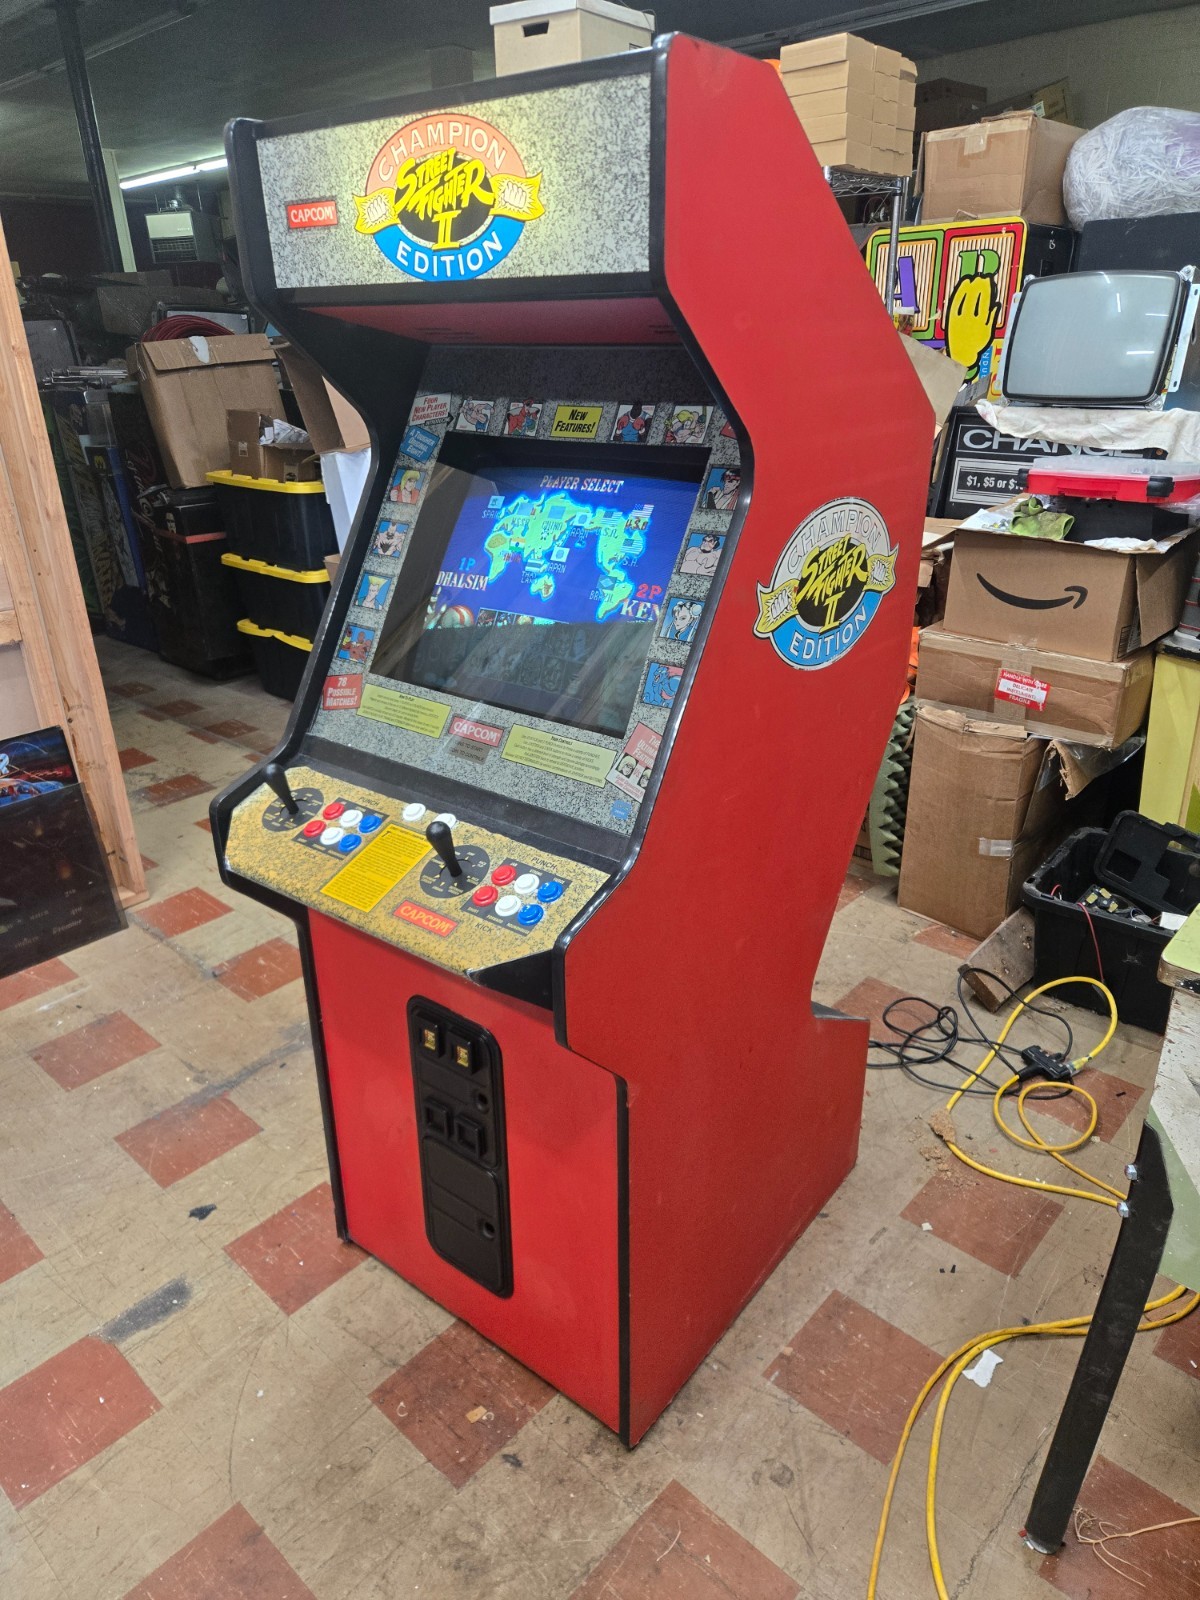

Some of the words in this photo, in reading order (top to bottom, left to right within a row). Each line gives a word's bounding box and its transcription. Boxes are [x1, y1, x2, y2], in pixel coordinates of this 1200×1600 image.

[379, 121, 507, 182] CHAMPION
[394, 147, 457, 214] STREET
[407, 158, 495, 221] FIGHTER
[290, 206, 334, 223] CAPCOM
[396, 231, 503, 277] EDITION
[568, 409, 588, 421] NEW
[554, 420, 597, 433] FEATURES!
[963, 429, 1143, 458] CHAN
[540, 475, 580, 490] PLAYER
[580, 478, 624, 493] SELECT
[966, 475, 981, 488] $1,
[983, 477, 995, 488] $5
[997, 480, 1007, 489] or
[787, 509, 881, 575] CHAMPION
[459, 557, 477, 571] 1P
[795, 533, 851, 605] STREET
[435, 571, 489, 591] DHALSIM
[807, 543, 869, 606] FIGHTER
[636, 583, 662, 600] 2P
[620, 599, 661, 621] KEN
[789, 603, 868, 660] EDITION
[328, 687, 357, 697] POSSIBLE
[337, 677, 348, 687] 78
[326, 696, 358, 707] MATCHES!
[453, 720, 500, 743] CAPCOM
[632, 747, 655, 767] FEATUR
[637, 740, 658, 757] ULTIMA
[531, 856, 558, 870] PUNCH
[400, 905, 450, 933] CAPCOM
[475, 922, 493, 934] KICK
